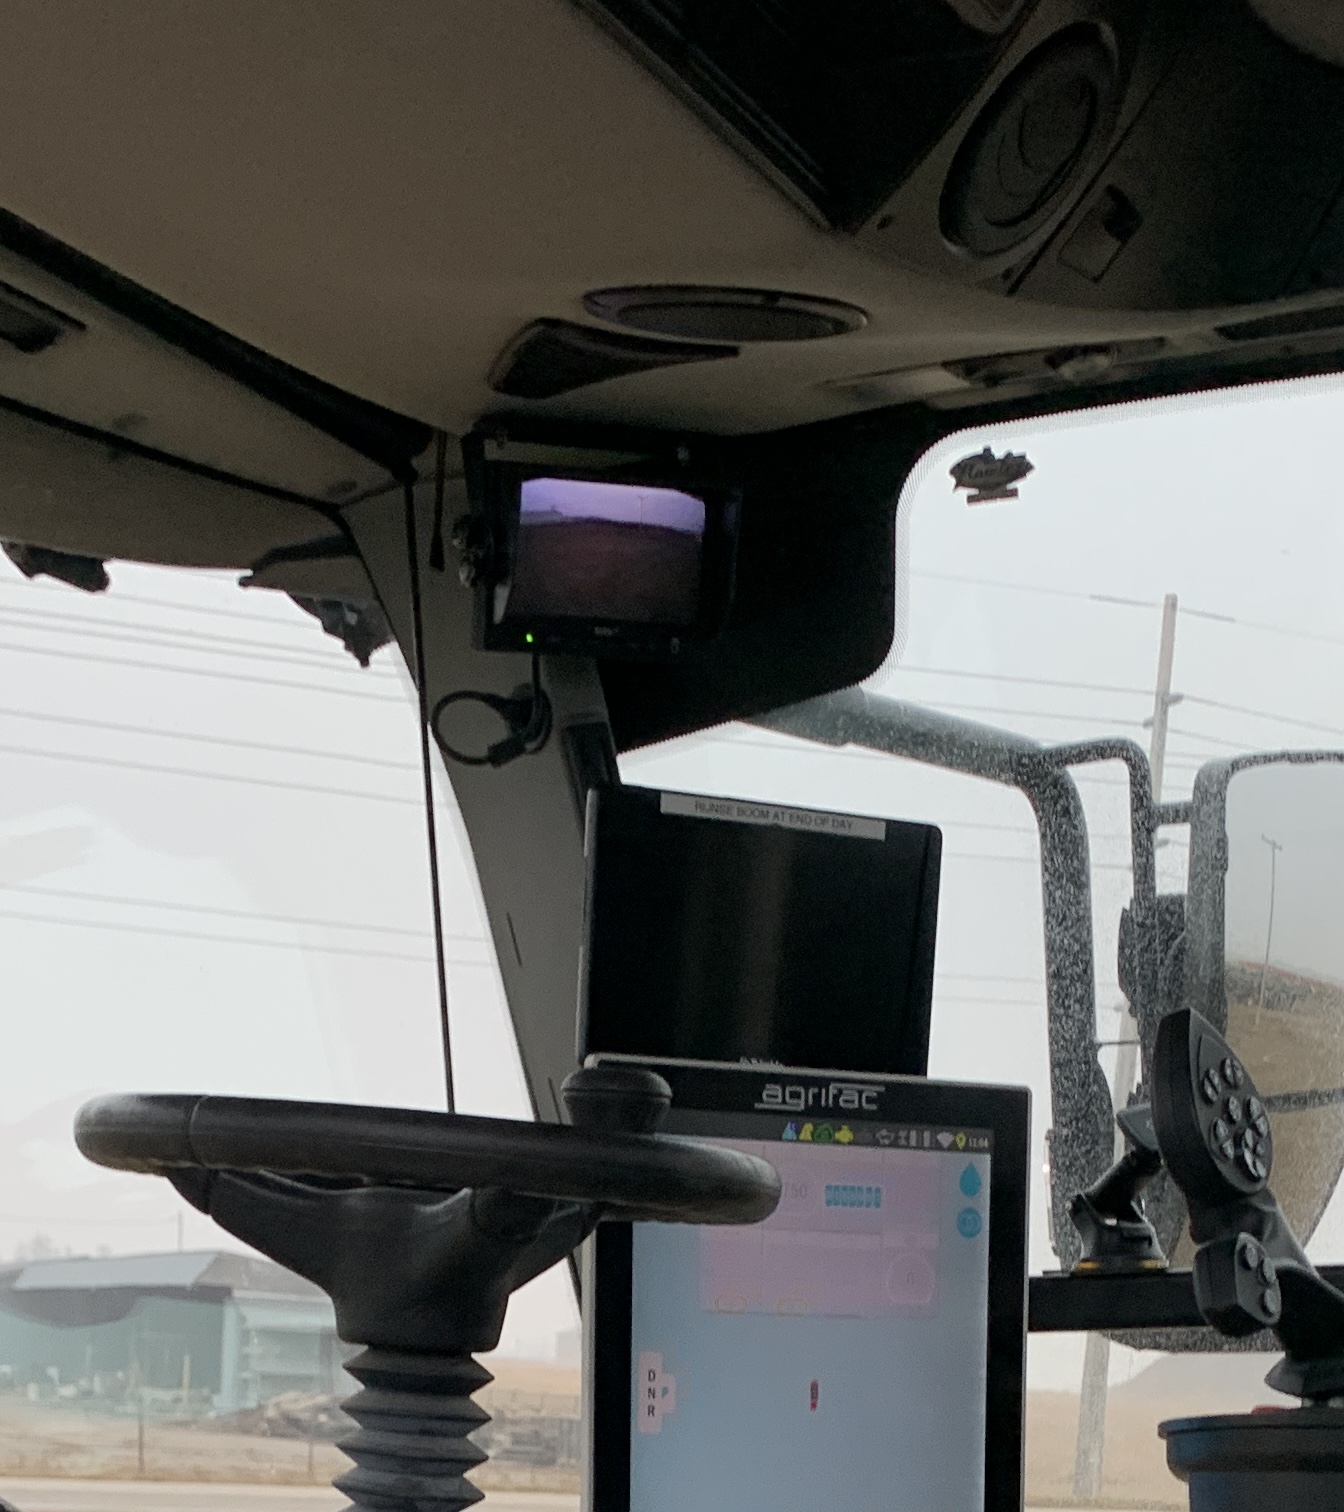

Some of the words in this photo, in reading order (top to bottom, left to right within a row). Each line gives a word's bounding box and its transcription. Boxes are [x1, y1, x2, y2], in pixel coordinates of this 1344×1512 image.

[736, 806, 769, 820] BOOM
[772, 811, 785, 823] AT
[788, 812, 812, 826] END
[814, 815, 829, 828] OF
[832, 817, 853, 831] DAY
[754, 1082, 886, 1112] agrifac
[648, 1369, 656, 1382] D
[647, 1386, 656, 1400] N
[647, 1404, 656, 1417] R
